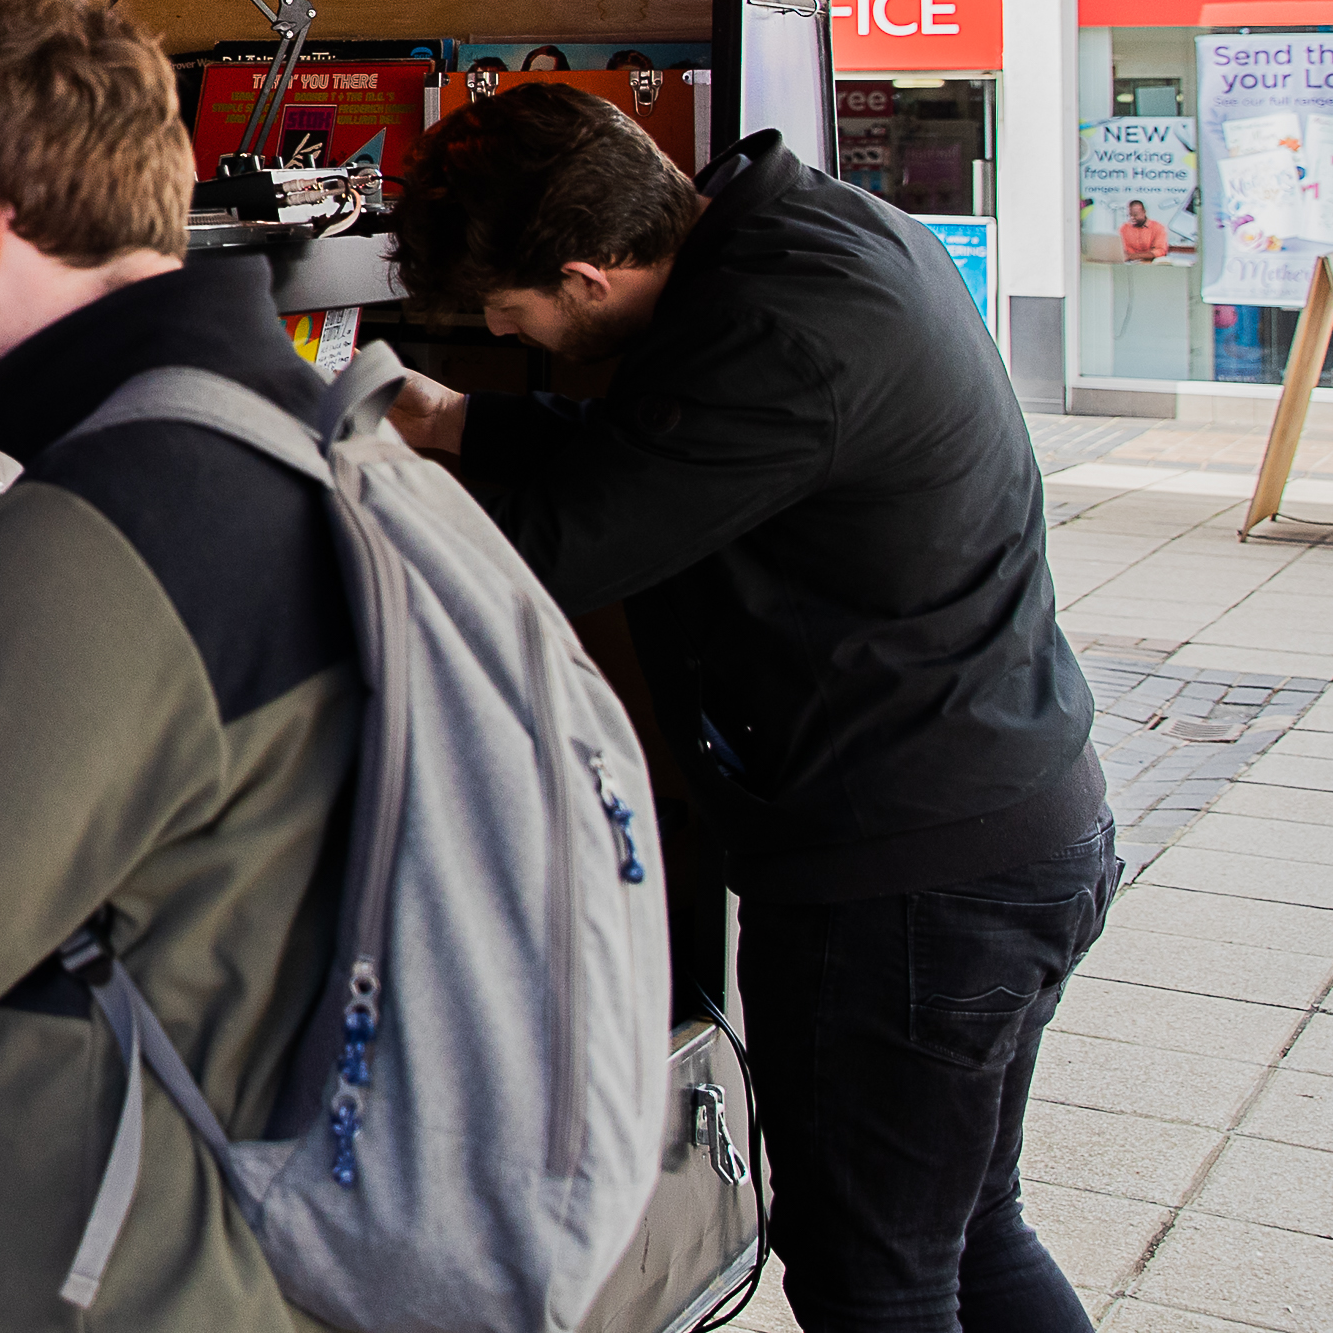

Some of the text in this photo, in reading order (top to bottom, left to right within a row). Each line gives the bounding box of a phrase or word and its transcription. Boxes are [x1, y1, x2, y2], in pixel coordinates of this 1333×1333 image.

[1214, 44, 1292, 66] Send
[300, 73, 379, 89] YOU THERE
[1222, 73, 1292, 94] your
[837, 90, 888, 112] ree
[1213, 96, 1239, 106] See
[1103, 125, 1170, 143] NEW
[1094, 149, 1173, 165] Working
[1084, 166, 1188, 181] from Home
